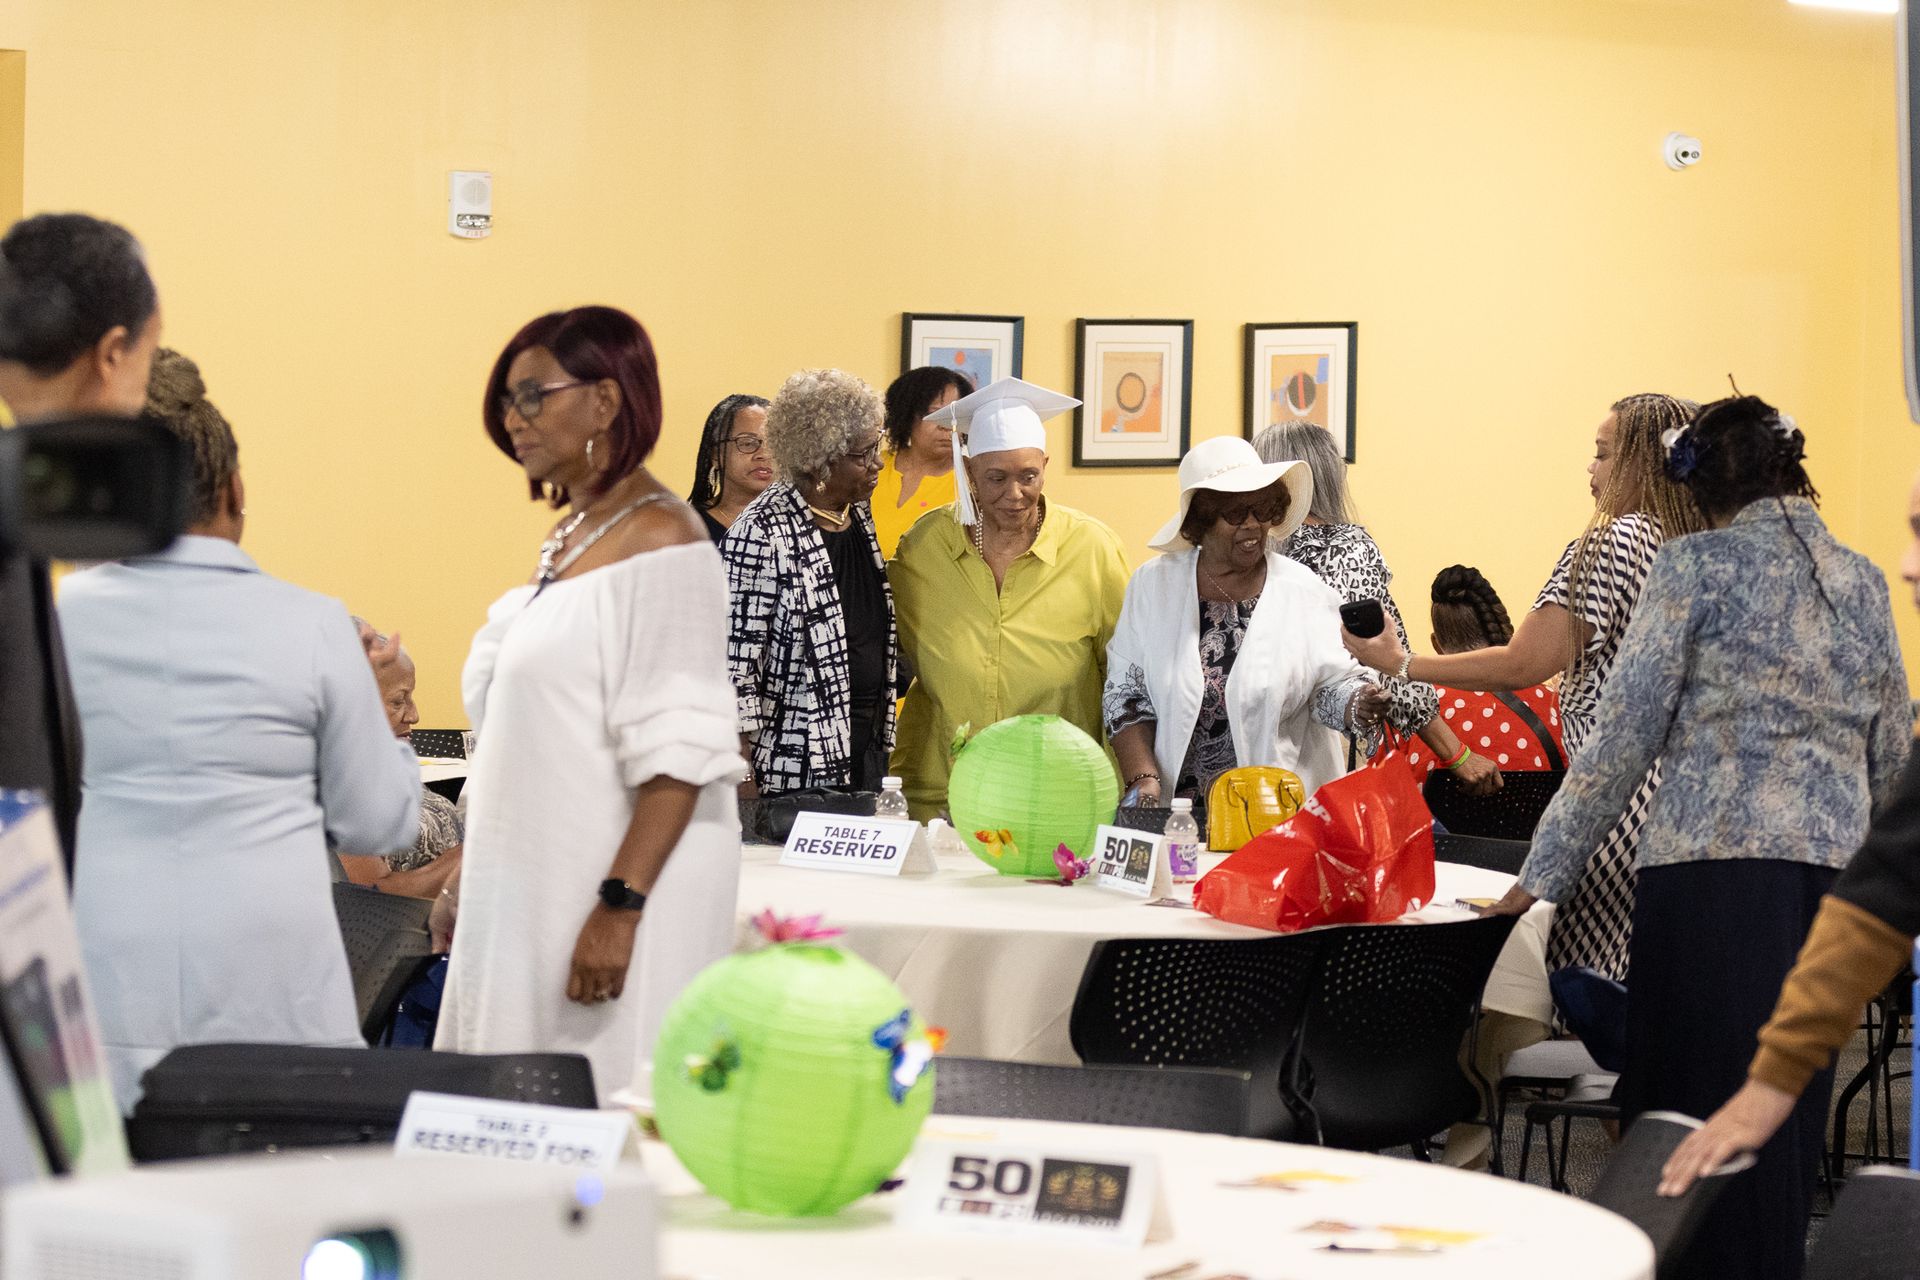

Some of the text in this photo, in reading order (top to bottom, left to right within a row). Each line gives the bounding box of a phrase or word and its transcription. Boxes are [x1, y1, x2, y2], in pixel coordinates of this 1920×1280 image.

[824, 826, 882, 841] TABLE 7
[793, 837, 897, 860] RESERVED
[1103, 836, 1129, 863] 50
[414, 1130, 537, 1162] RESERVED
[949, 1156, 1032, 1196] 50
